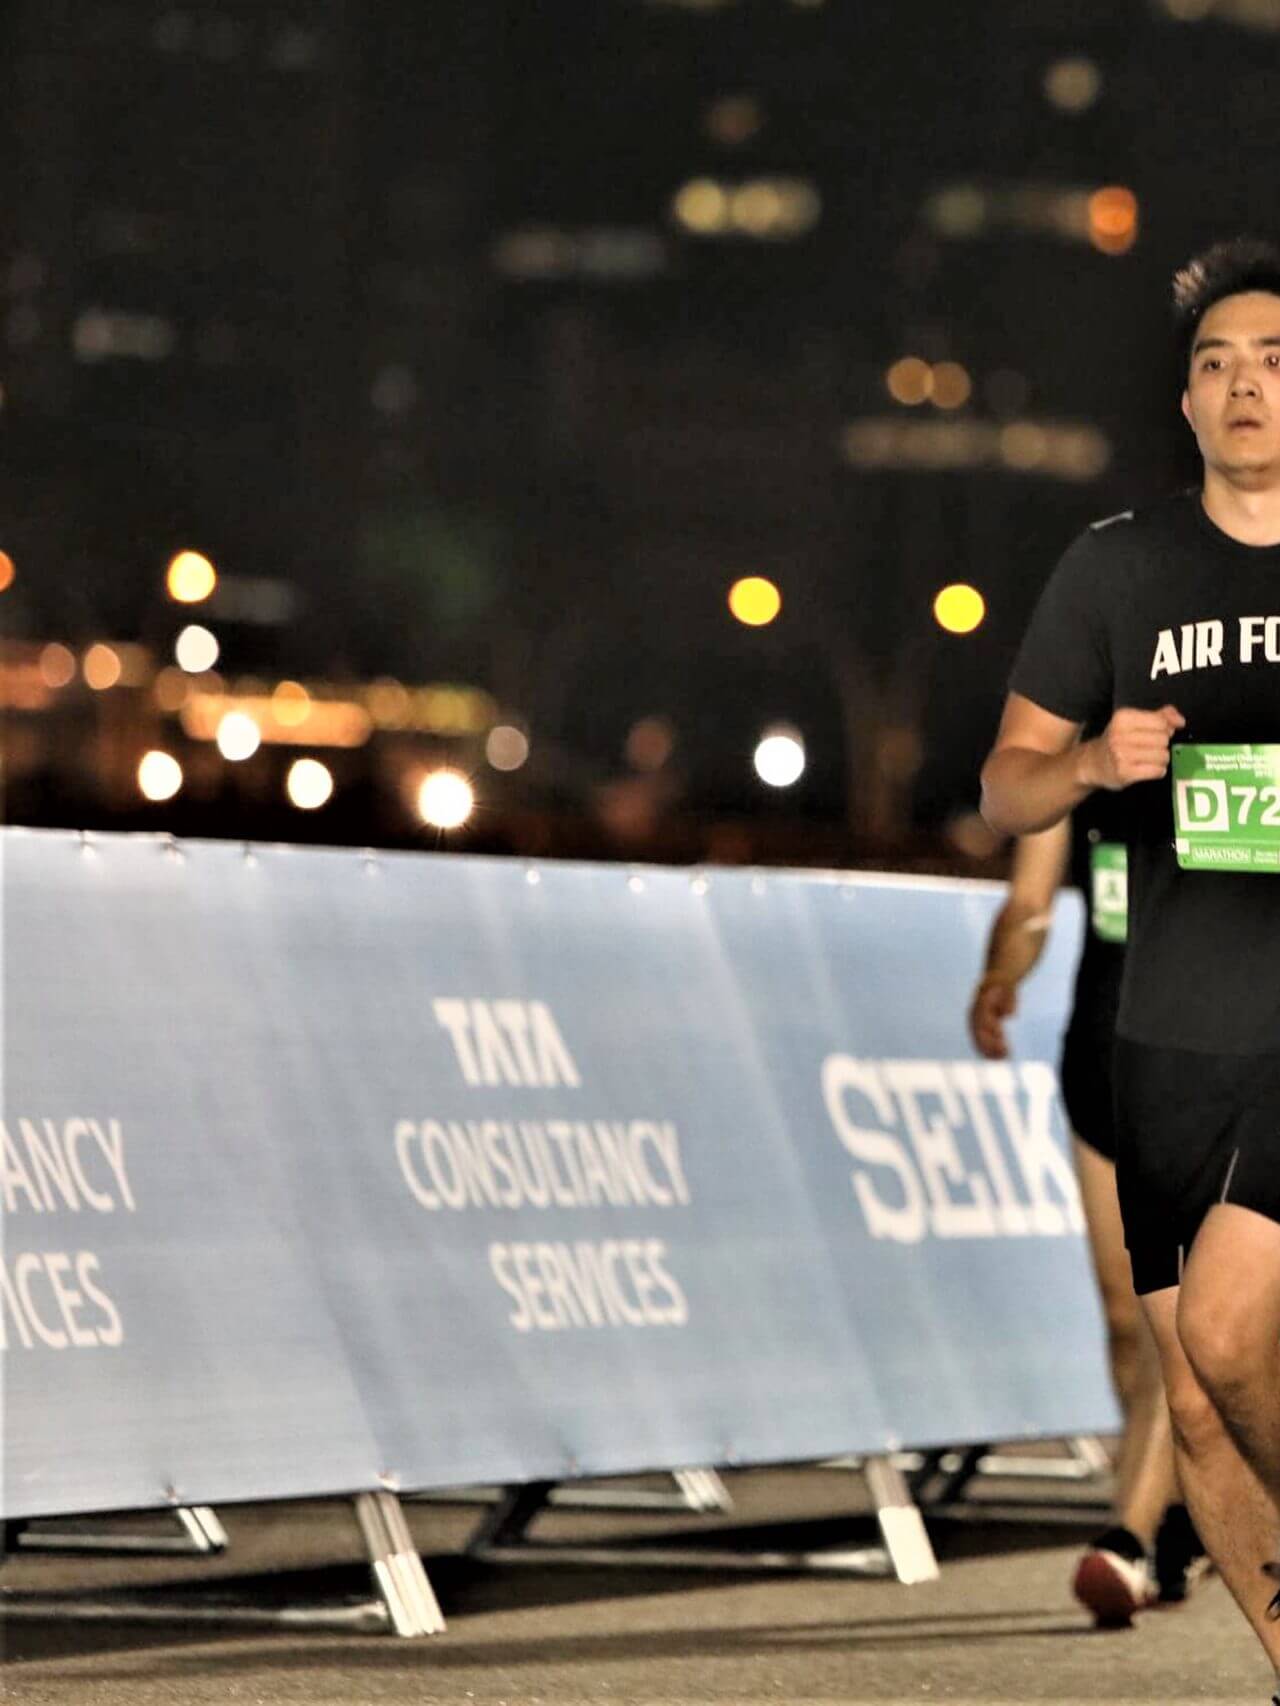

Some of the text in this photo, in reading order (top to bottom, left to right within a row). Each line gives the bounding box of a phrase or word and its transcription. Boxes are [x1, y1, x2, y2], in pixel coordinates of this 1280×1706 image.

[1150, 619, 1224, 680] AIR
[432, 997, 582, 1087] TATA
[394, 1119, 690, 1210] CONSULTANCY
[821, 1053, 1086, 1244] SEIK
[0, 1251, 124, 1348] ICES
[489, 1238, 689, 1332] SERVICES
